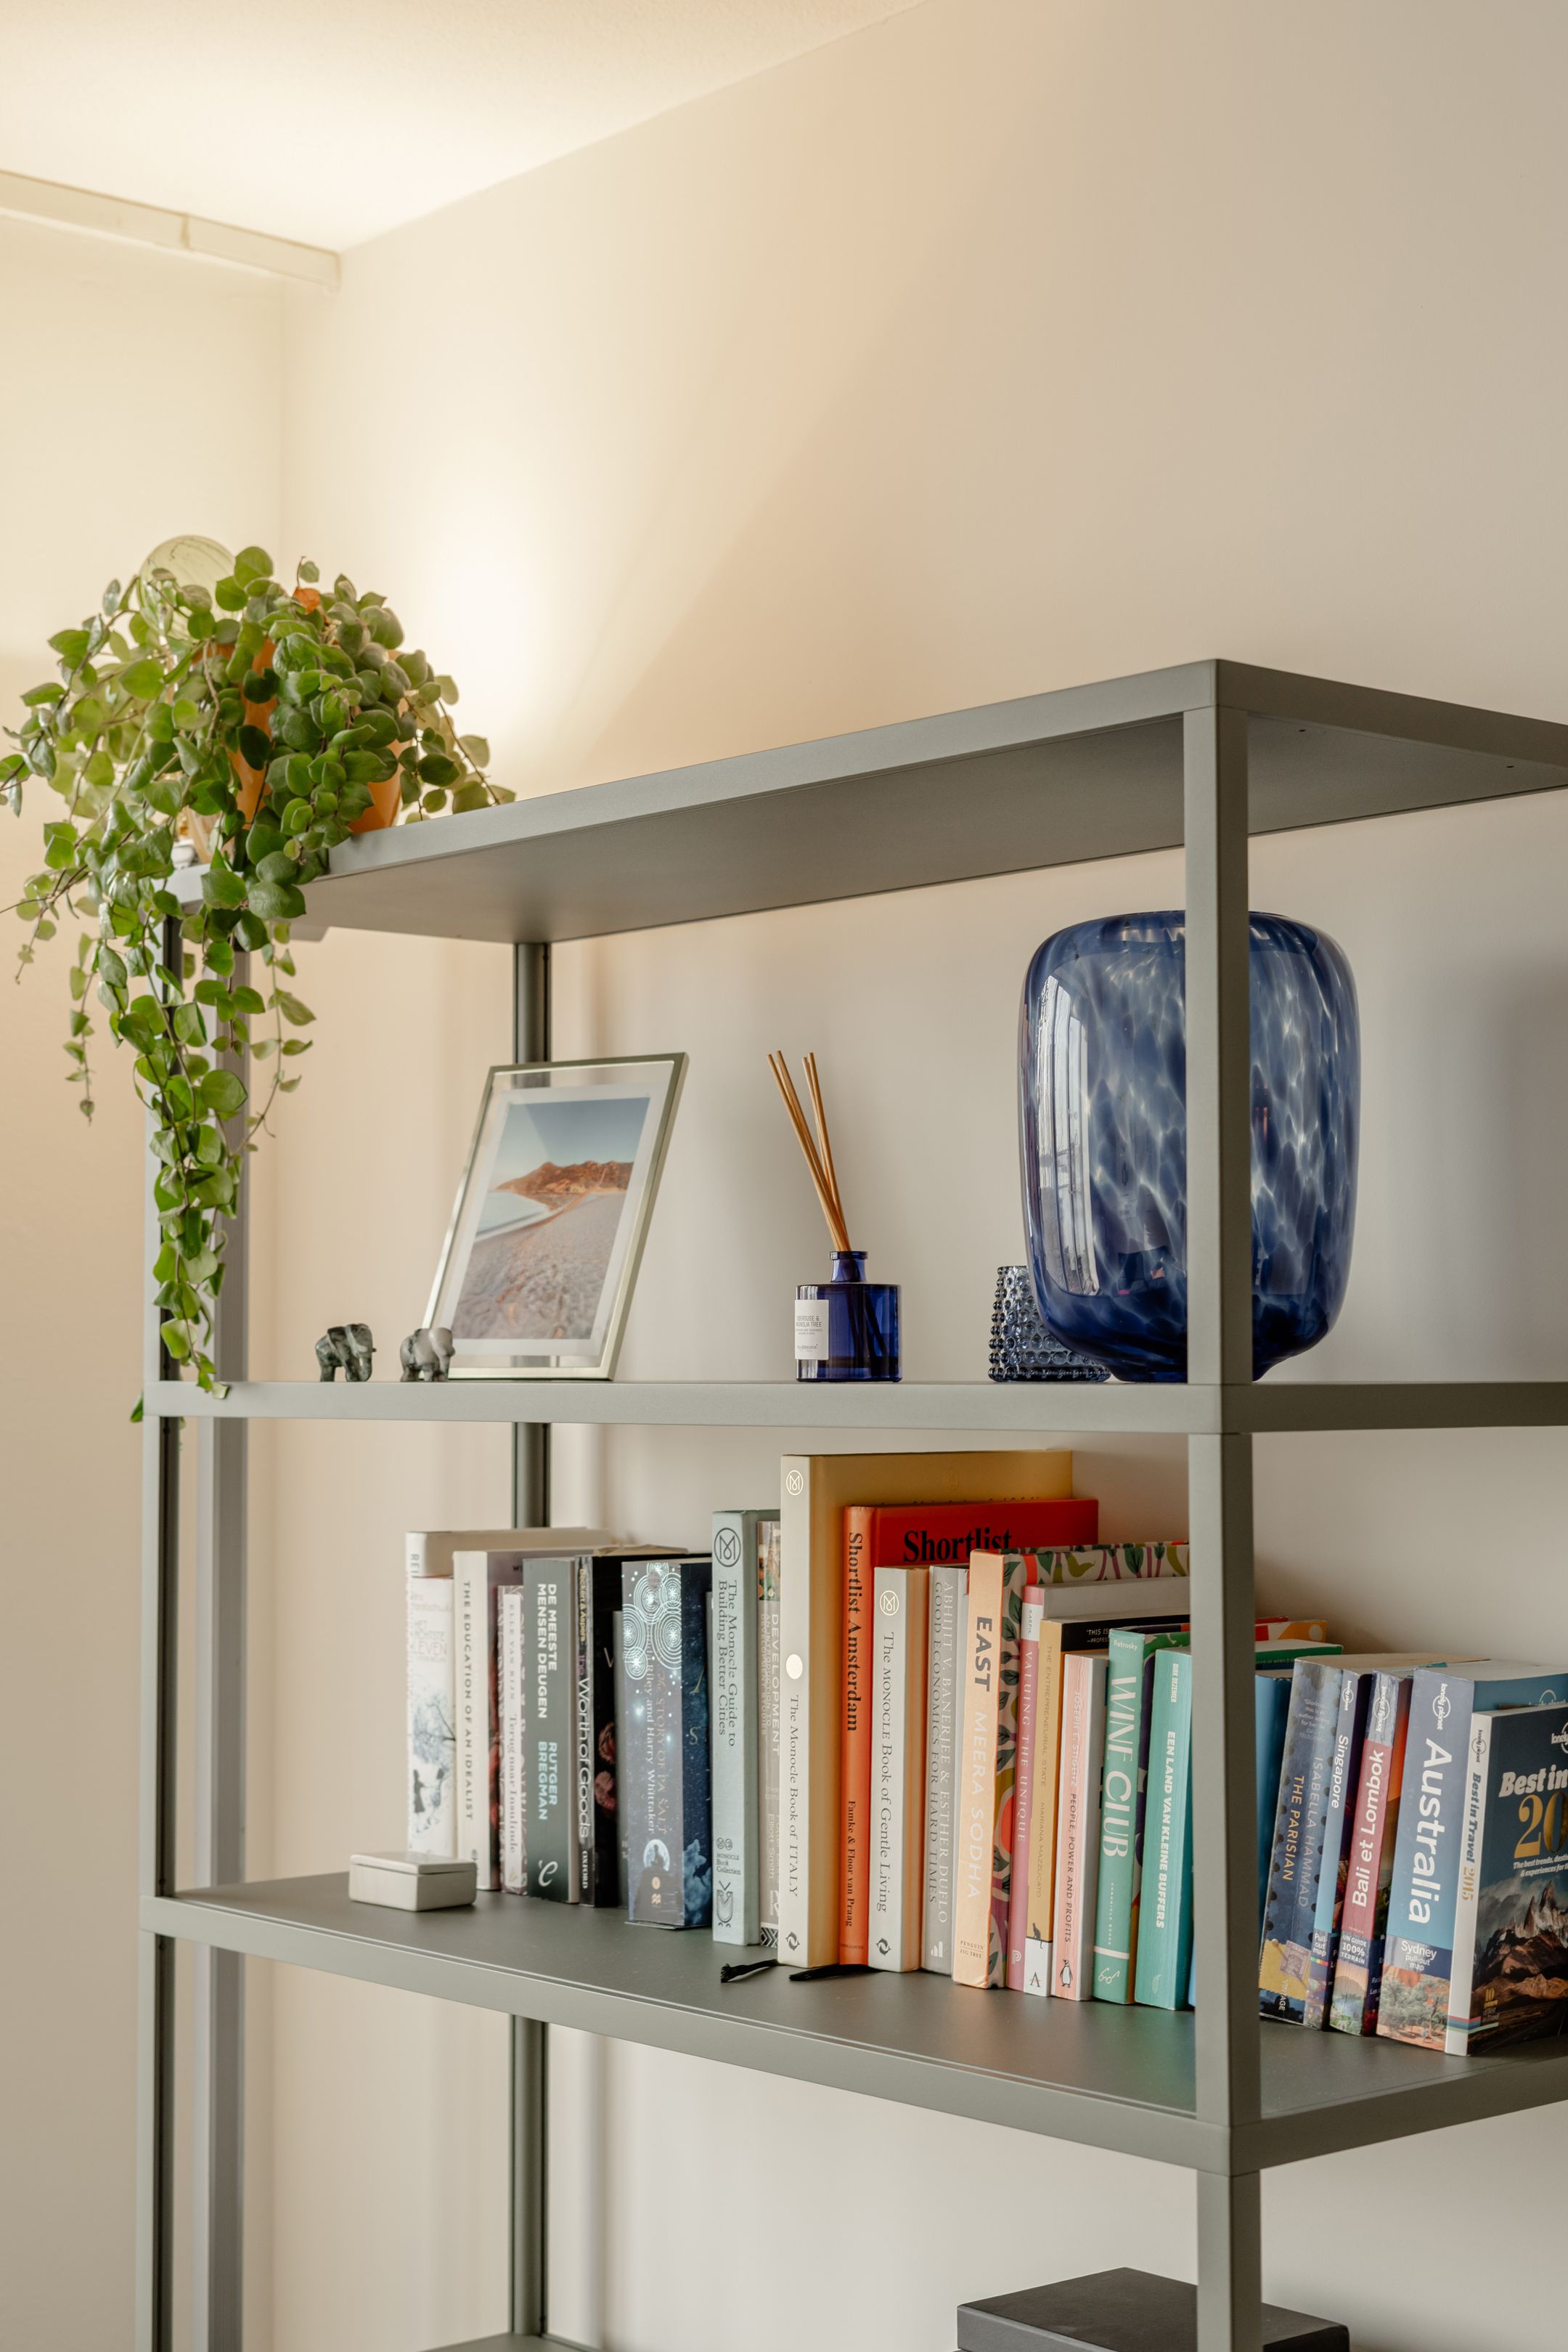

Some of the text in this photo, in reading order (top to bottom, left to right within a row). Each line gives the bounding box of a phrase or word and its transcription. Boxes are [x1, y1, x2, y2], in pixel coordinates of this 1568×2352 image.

[904, 1527, 1012, 1563] Shortlist
[463, 1614, 472, 1699] EDUCATION
[537, 1584, 547, 1719] MENSEN DEUGEN
[547, 1584, 558, 1671] DE MEESTE
[716, 1580, 728, 1735] Building Better Cities
[847, 1532, 863, 1732] Shortlist Amsterdam
[1114, 1639, 1138, 1652] Petrosky
[644, 1665, 654, 1695] Riley
[728, 1580, 738, 1747] The Monocle Guide to
[771, 1614, 780, 1756] DEVELOPMENT
[1169, 1663, 1180, 1703] DIRK BEZEMER
[465, 1705, 473, 1724] OF
[507, 1714, 518, 1753] Terug
[1042, 1667, 1052, 1755] ENTREPRENEURIAL
[1376, 1711, 1386, 1732] lonely
[1435, 1682, 1449, 1730] lonely planet
[465, 1729, 473, 1748] AN
[578, 1677, 591, 1839] Worth of Goods
[645, 1728, 655, 1765] Harry
[656, 1698, 667, 1835] STORY OF PA SALT
[929, 1582, 942, 1903] GOOD ECONOMICS FOR HARD TIMES
[938, 1582, 954, 1923] ABHIJIT V. BANERJEE & ESTHER DUFLO
[967, 1616, 993, 1900] EAST MEERA SODHA
[1017, 1651, 1033, 1842] VALUING THE UNIQUE
[1103, 1676, 1137, 1857] WINE CLUB
[538, 1741, 548, 1820] BREGMAN
[548, 1742, 558, 1806] RUTGER
[647, 1770, 656, 1834] Whittaker
[789, 1695, 799, 1898] The Monocle Book of ITALY
[876, 1631, 894, 1913] The MONOCLE Book of Gentle Living
[1306, 1756, 1323, 1828] ISABELLA
[1331, 1734, 1349, 1808] Singapore
[1498, 1764, 1568, 1798] Best in
[510, 1791, 518, 1853] Insulinde
[847, 1800, 857, 1833] Famke
[1068, 1793, 1077, 1832] PEOPLE,
[1156, 1731, 1176, 1928] EEN LAND VAN KLEINE BUFFERS
[1282, 1775, 1305, 1881] THE PARISIAN
[1351, 1750, 1384, 1908] Bali et Lombok
[1408, 1738, 1453, 1924] Australia
[1461, 1773, 1482, 1901] Best in Travel 2015
[1514, 1791, 1568, 1859] 20
[716, 1865, 741, 1875] Collection
[847, 1849, 856, 1874] Floor
[1067, 1836, 1076, 1873] POWER
[1298, 1835, 1315, 1907] HAMMAD
[1513, 1861, 1524, 1870] The
[1535, 1856, 1554, 1866] trends,
[1525, 1865, 1557, 1876] experiences
[1556, 1863, 1565, 1872] for
[845, 1897, 855, 1926] Praag
[1064, 1902, 1073, 1942] PROFITS
[1315, 1933, 1327, 1942] Pull-
[1351, 1936, 1367, 1947] GUIDE
[960, 1940, 984, 1950] PENGUIN
[1312, 1948, 1326, 1956] map
[1341, 1951, 1365, 1964] TERRAIN
[1342, 1942, 1365, 1956] 100%
[1400, 1940, 1437, 1961] Sydney
[1405, 1954, 1430, 1966] pull-out
[1410, 1963, 1425, 1971] map
